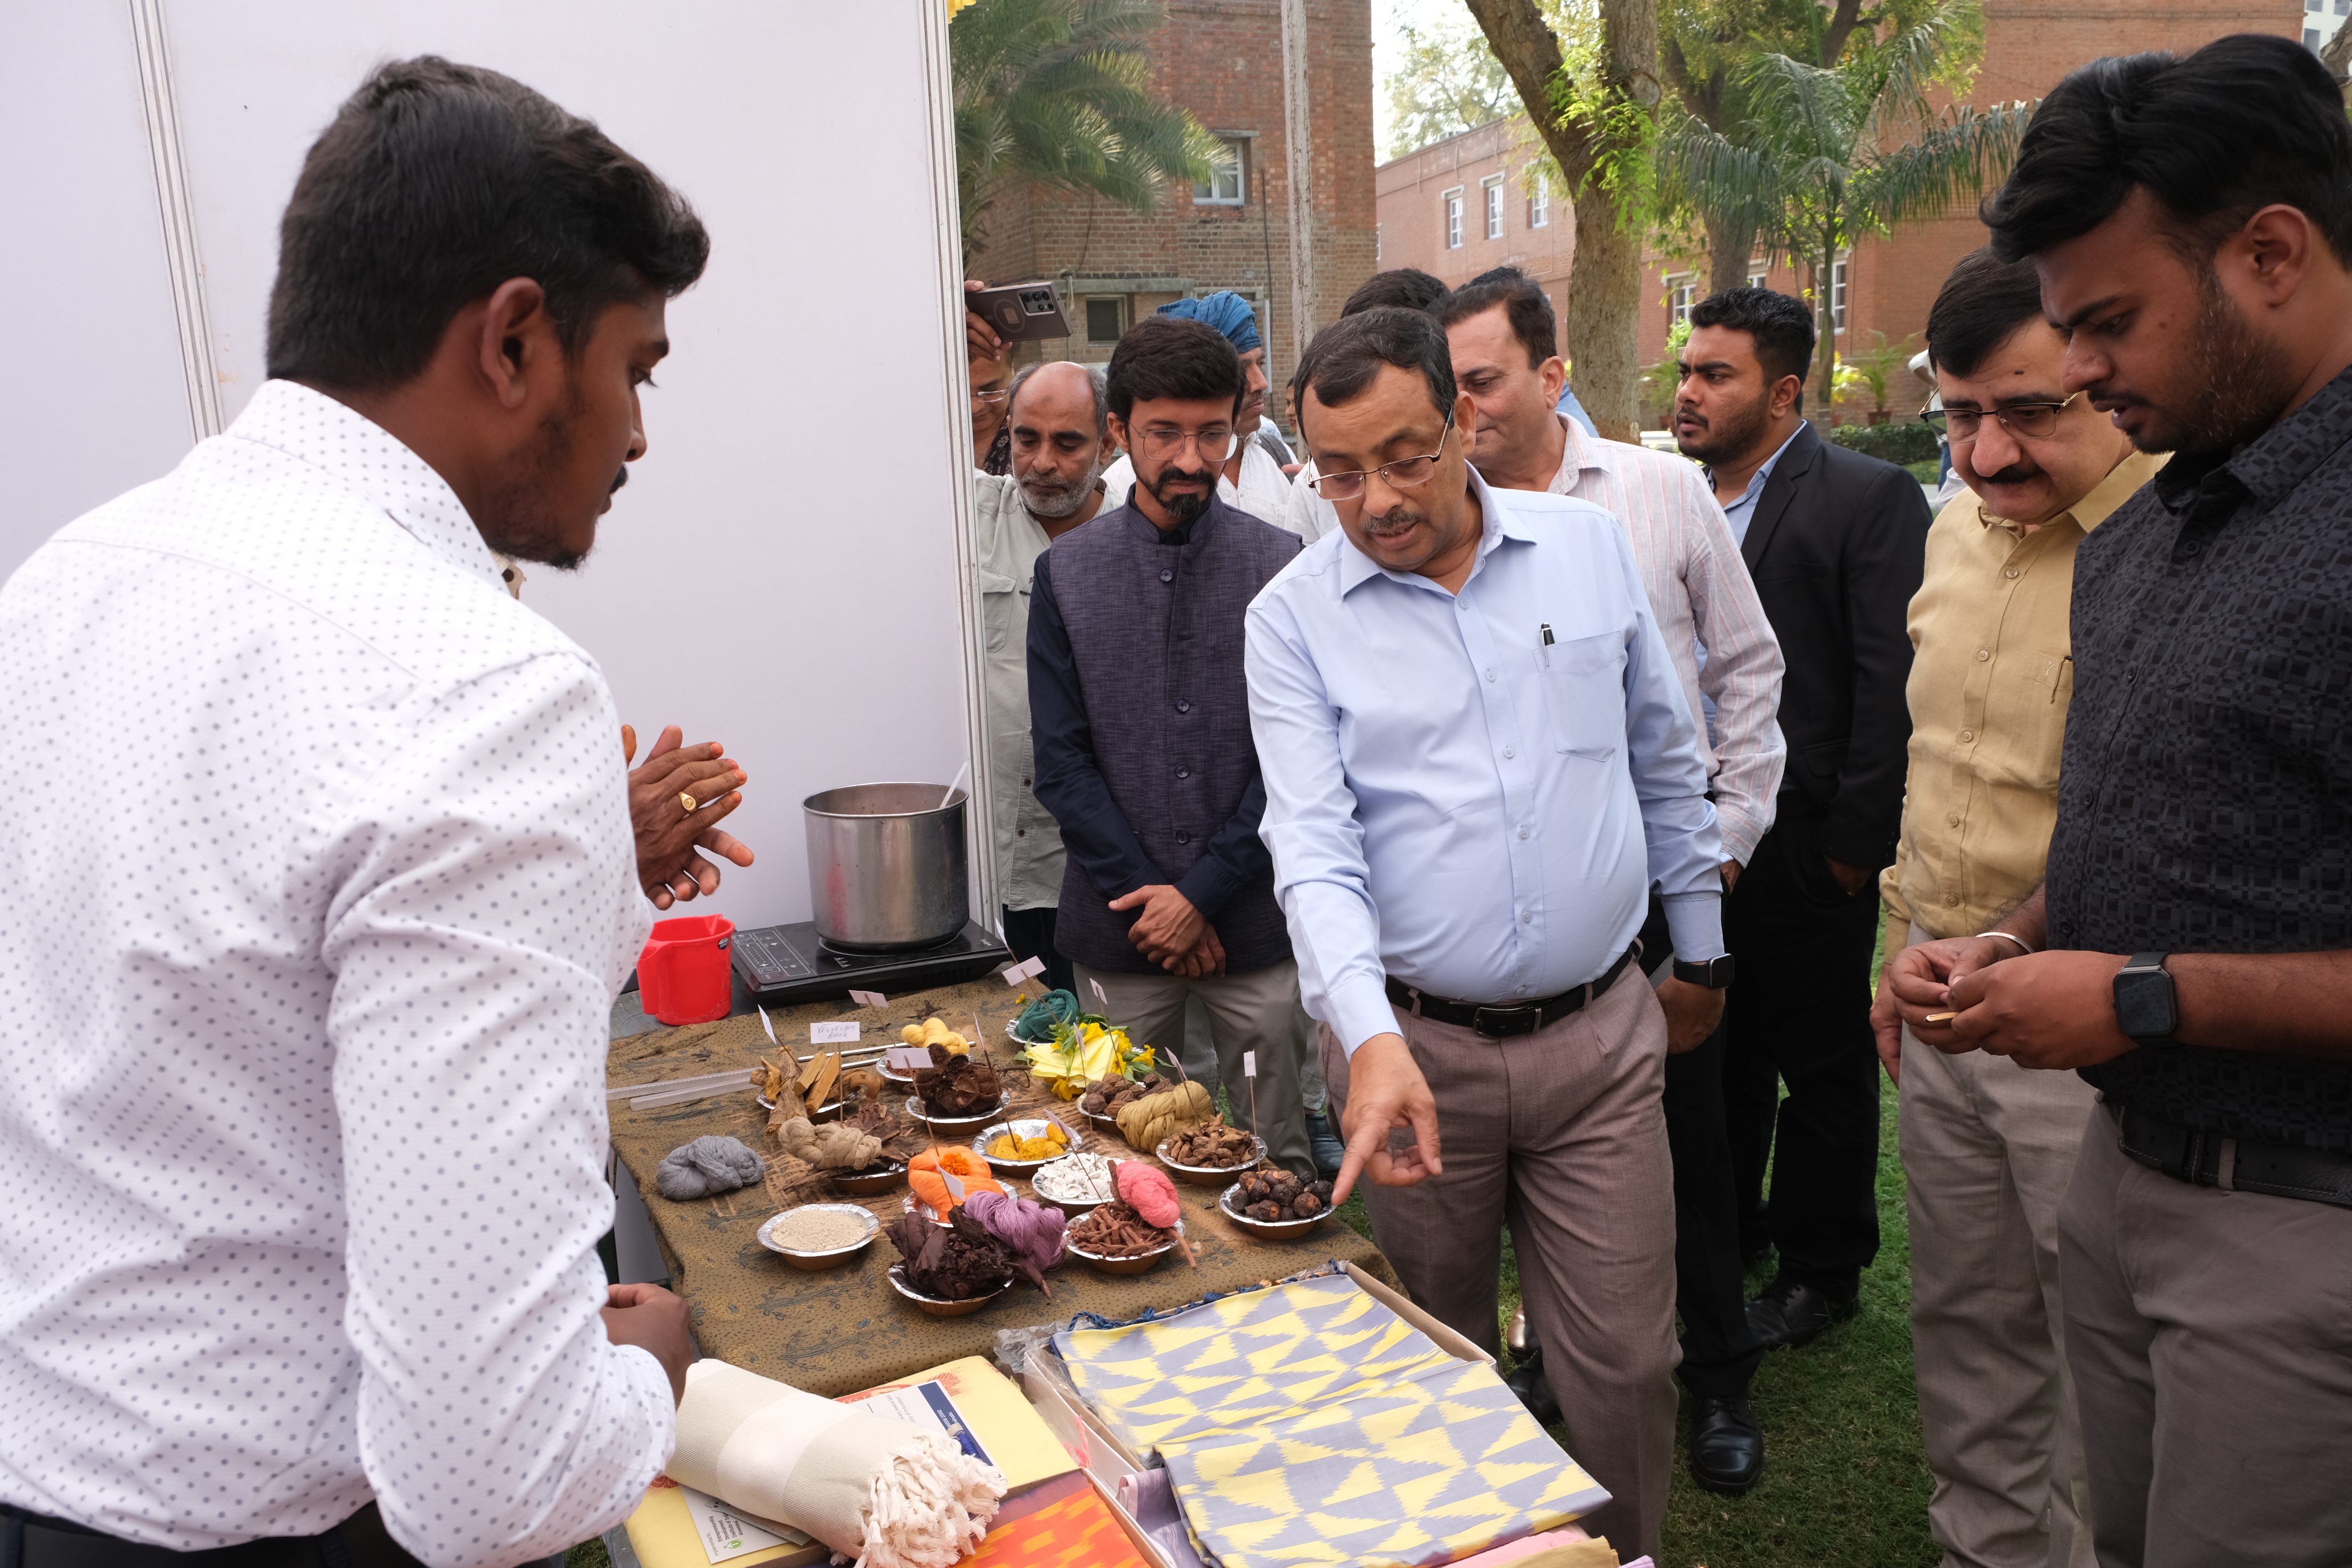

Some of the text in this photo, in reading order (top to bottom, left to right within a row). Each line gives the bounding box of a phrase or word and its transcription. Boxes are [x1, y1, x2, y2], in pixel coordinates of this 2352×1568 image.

[828, 1031, 848, 1039] BARK
[708, 1516, 723, 1542] Entrepreneurship
[717, 1519, 730, 1540] Development
[728, 1523, 737, 1538] Institute
[707, 1536, 719, 1556] Implemented
